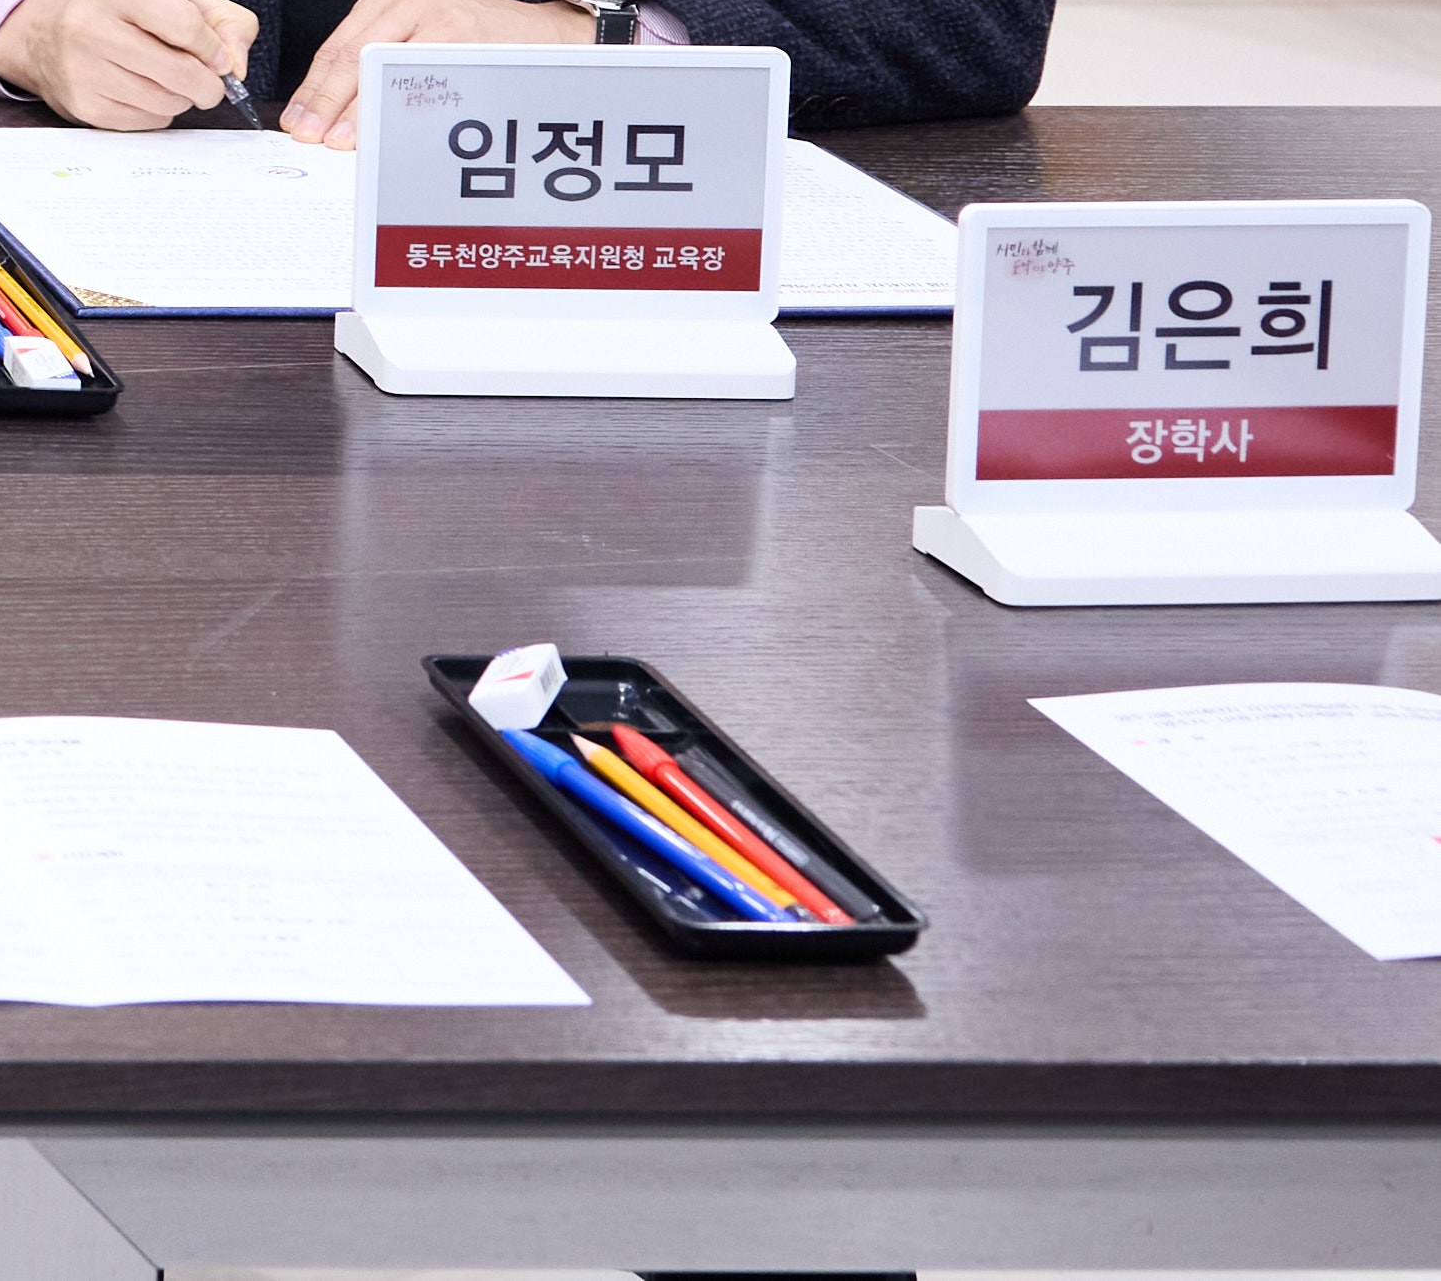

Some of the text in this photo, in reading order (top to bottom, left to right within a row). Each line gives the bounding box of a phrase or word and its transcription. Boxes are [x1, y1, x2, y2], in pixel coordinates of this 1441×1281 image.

[449, 119, 693, 202] 임정모
[407, 244, 725, 271] 동두천양주교육지원청 교육장
[1068, 280, 1332, 371] 김은희
[1125, 418, 1254, 465] 장학사
